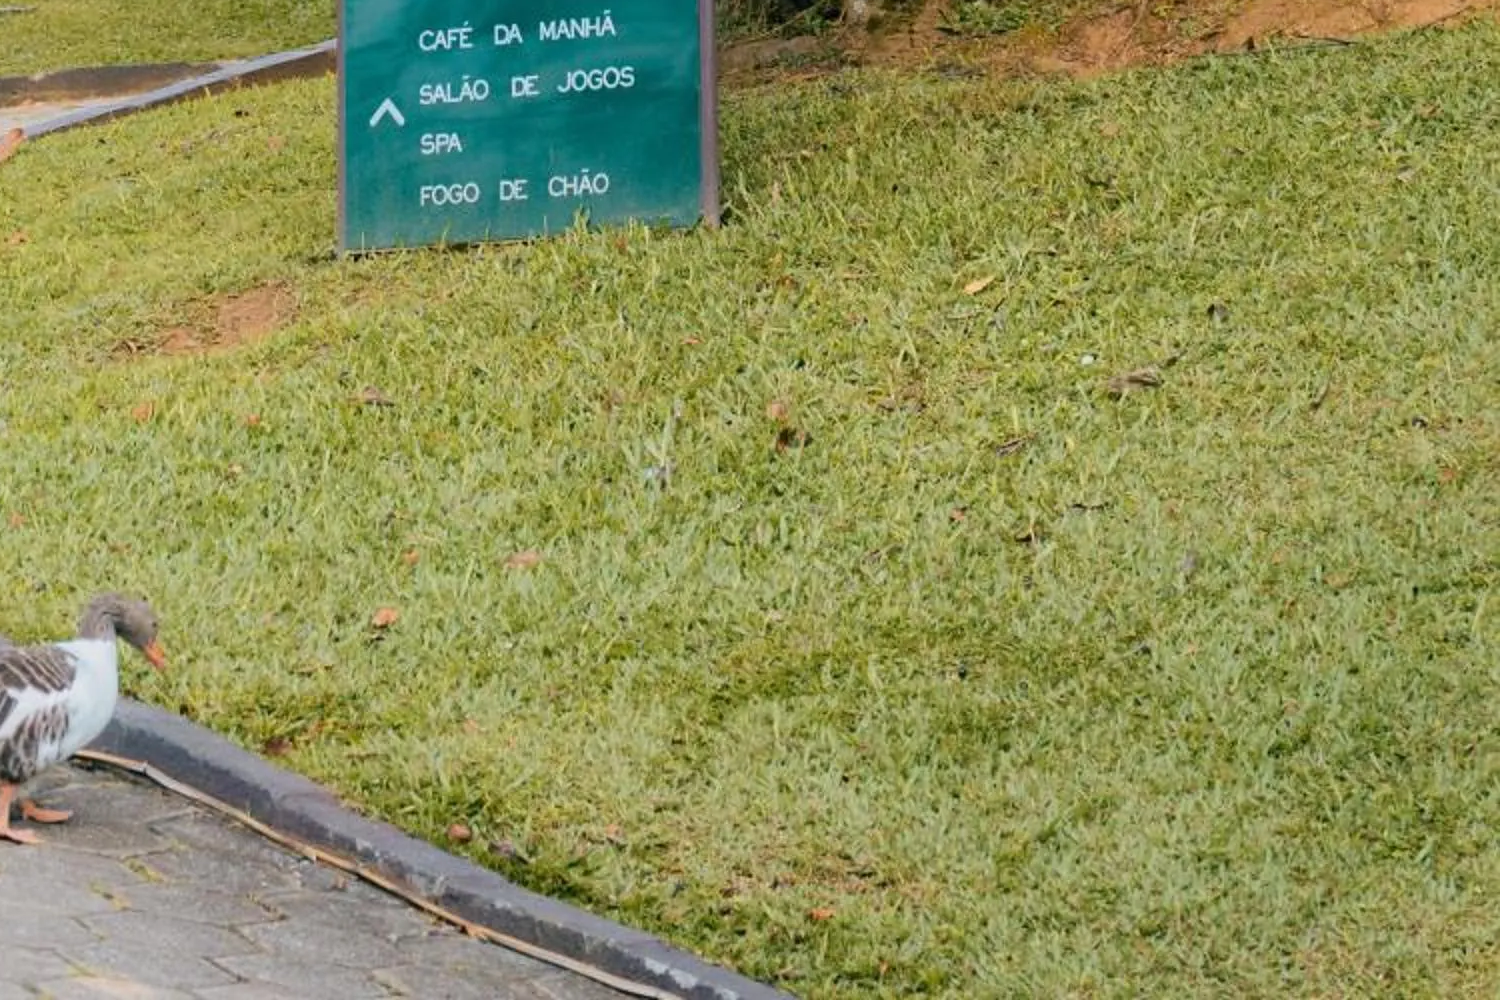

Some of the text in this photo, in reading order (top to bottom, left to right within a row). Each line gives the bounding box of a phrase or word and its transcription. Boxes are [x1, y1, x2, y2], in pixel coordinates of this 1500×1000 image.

[418, 9, 616, 52] CAFÉ DA MANHÃ
[419, 66, 636, 106] SALÃO DE JOGOS
[419, 132, 463, 156] SPA
[419, 168, 610, 207] FOGO DE CHÃO
